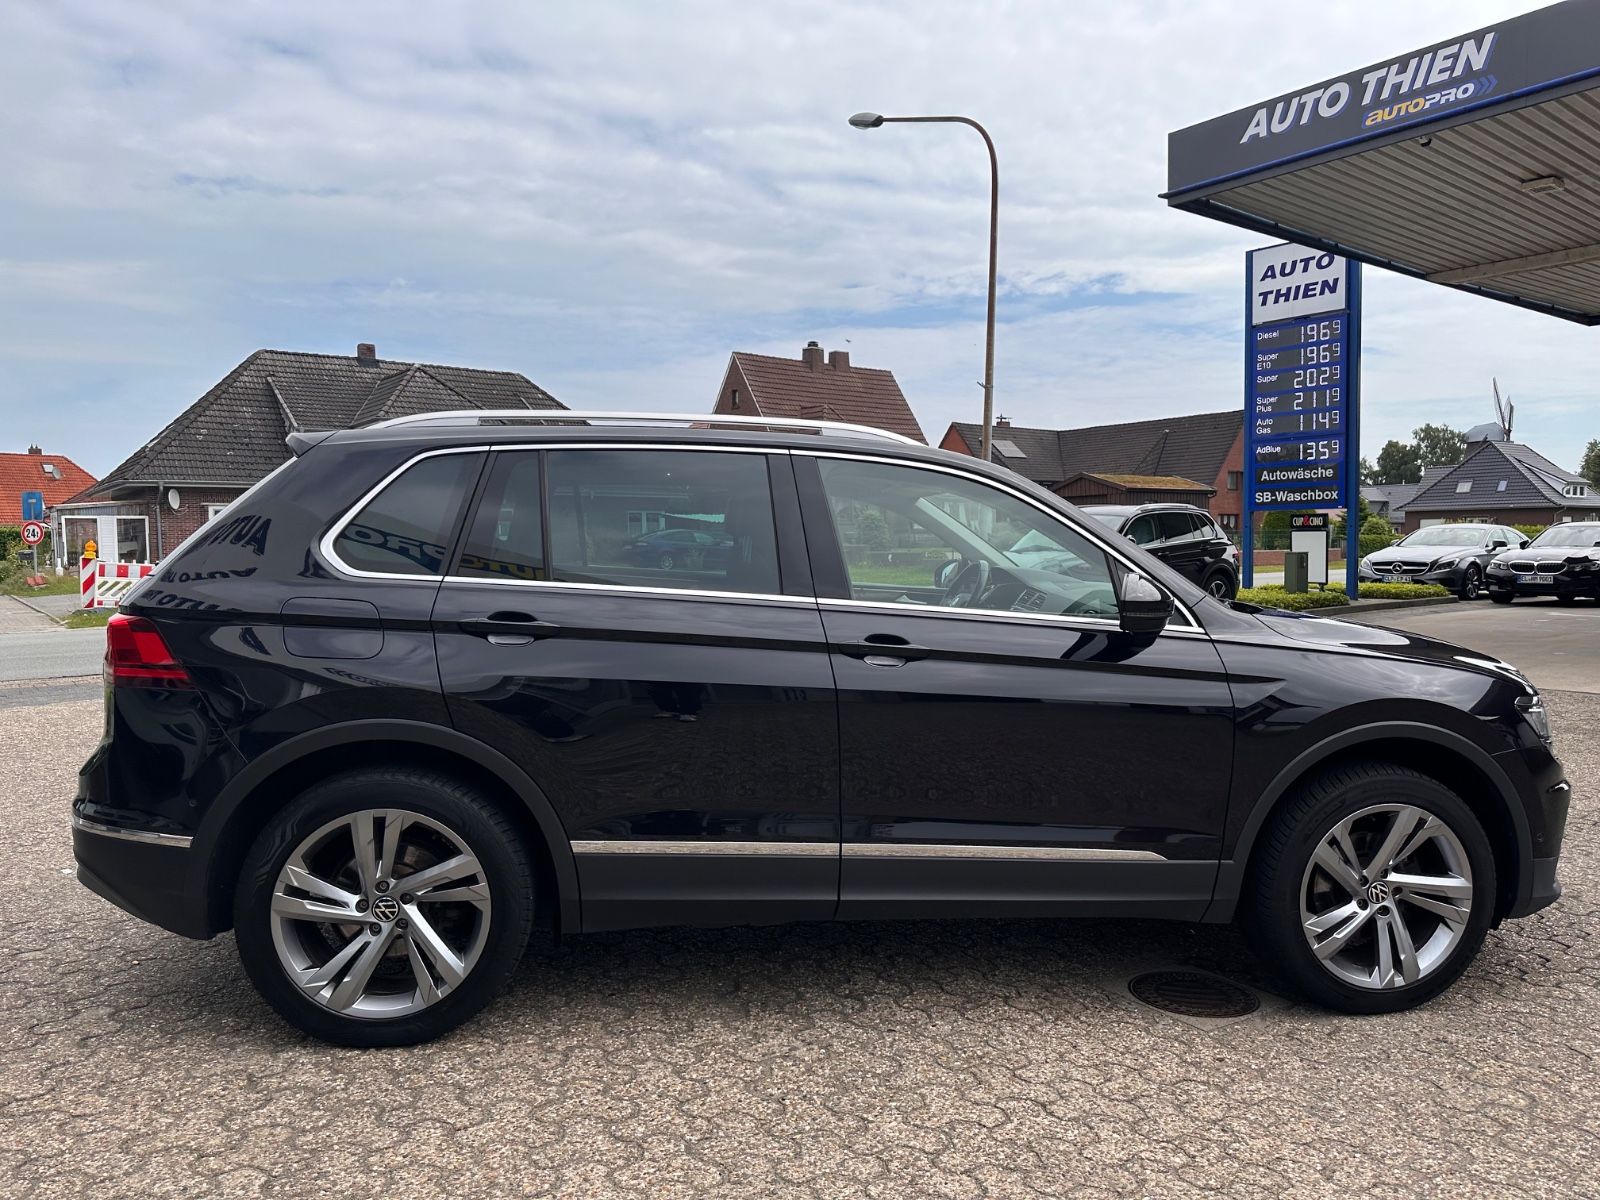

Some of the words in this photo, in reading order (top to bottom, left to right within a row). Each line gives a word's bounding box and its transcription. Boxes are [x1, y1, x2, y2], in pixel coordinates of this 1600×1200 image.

[1239, 82, 1351, 144] AUTO
[1361, 32, 1497, 106] THIEN
[1260, 252, 1335, 281] AUTO
[1258, 277, 1340, 307] THIEN
[1257, 330, 1279, 340] Diesel
[1257, 353, 1279, 363] Super
[1256, 362, 1271, 371] E10
[1257, 374, 1279, 384] Super
[1256, 396, 1278, 406] Super
[1256, 405, 1272, 413] Plus
[1256, 418, 1274, 426] Auto
[1256, 426, 1271, 434] Gas
[1256, 445, 1281, 454] AdBlue
[1260, 467, 1334, 481] Autowäsche
[1255, 489, 1338, 503] SB-Waschbox
